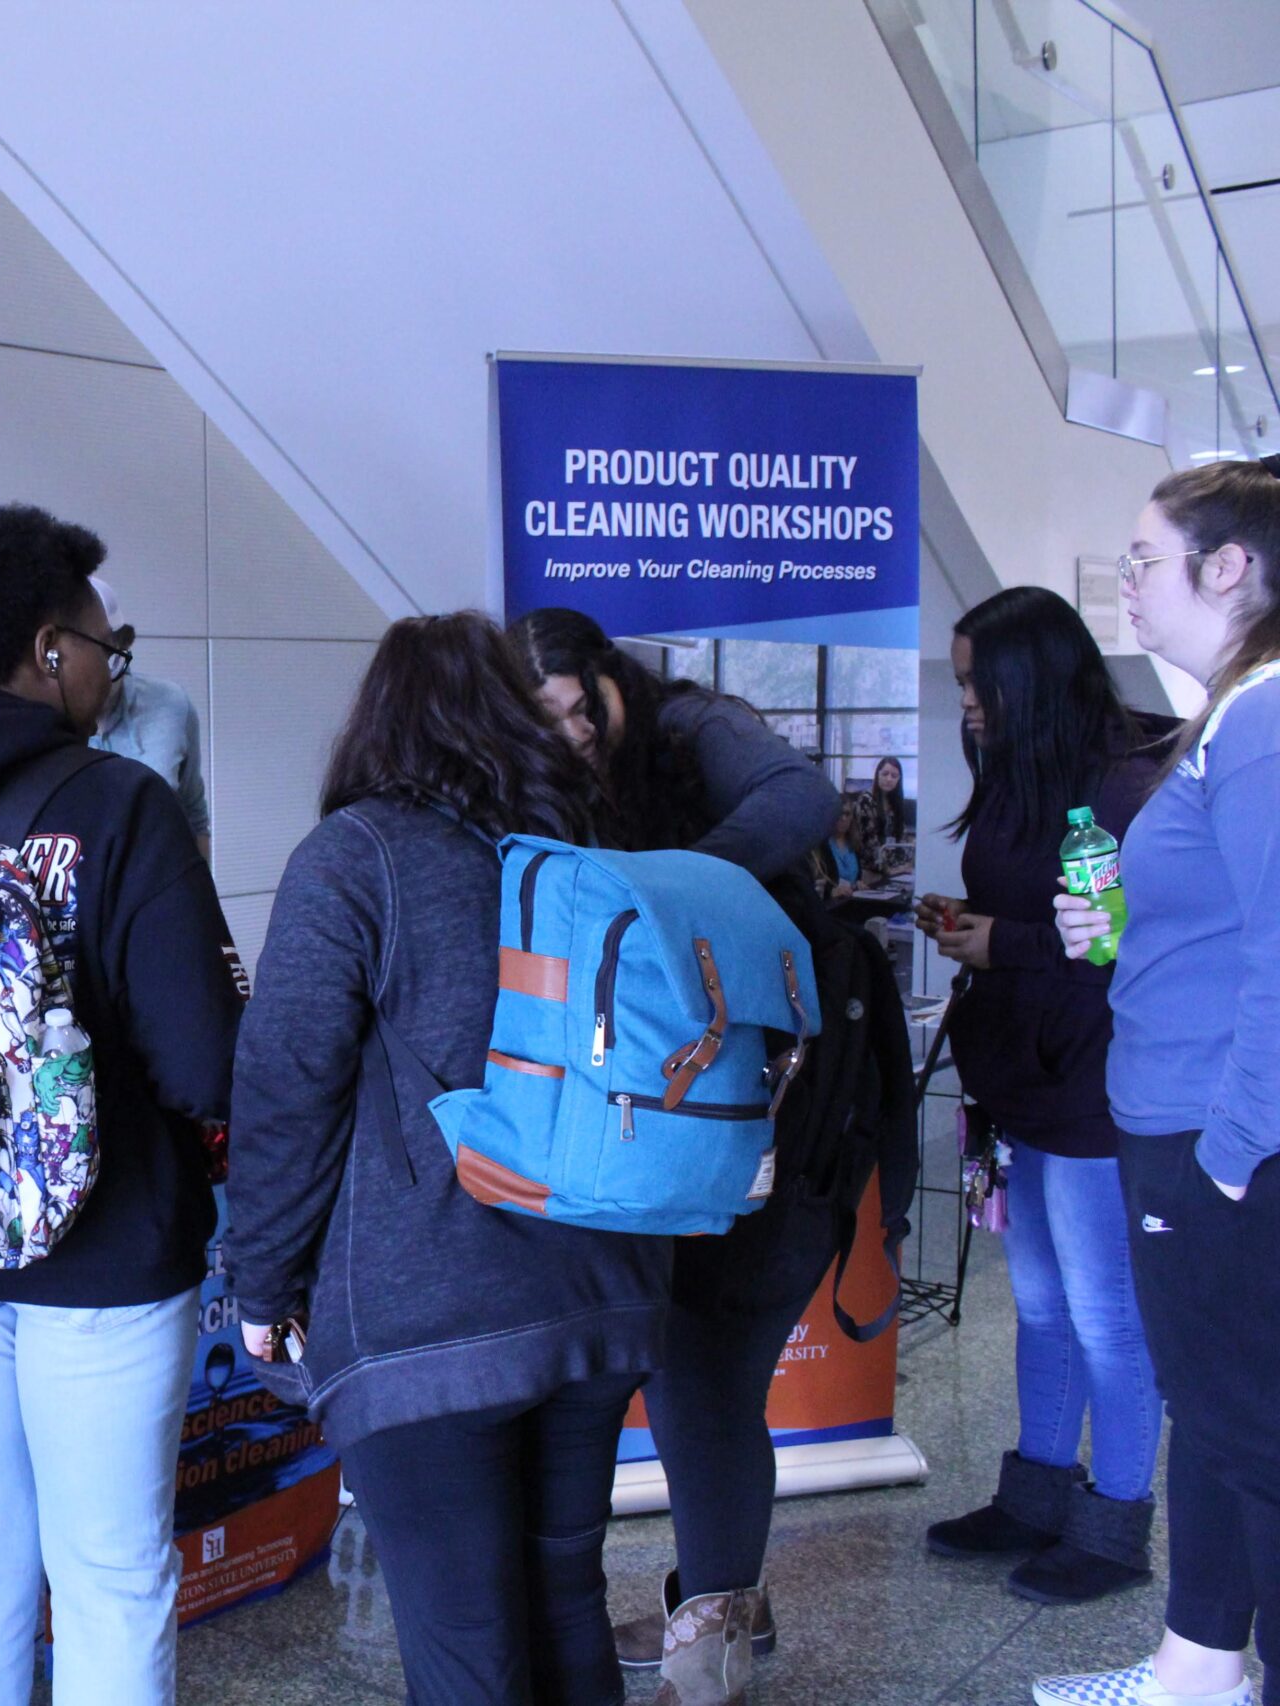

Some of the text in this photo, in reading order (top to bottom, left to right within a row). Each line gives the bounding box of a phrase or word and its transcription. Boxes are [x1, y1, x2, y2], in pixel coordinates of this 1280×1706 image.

[565, 449, 858, 490] PRODUCT QUALITY
[524, 500, 893, 541] CLEANING WORKSHOPS
[545, 558, 877, 583] Improve Your Cleaning Processes
[59, 918, 76, 931] safe
[208, 1570, 237, 1590] STATE
[239, 1548, 297, 1578] UNIVERSITY
